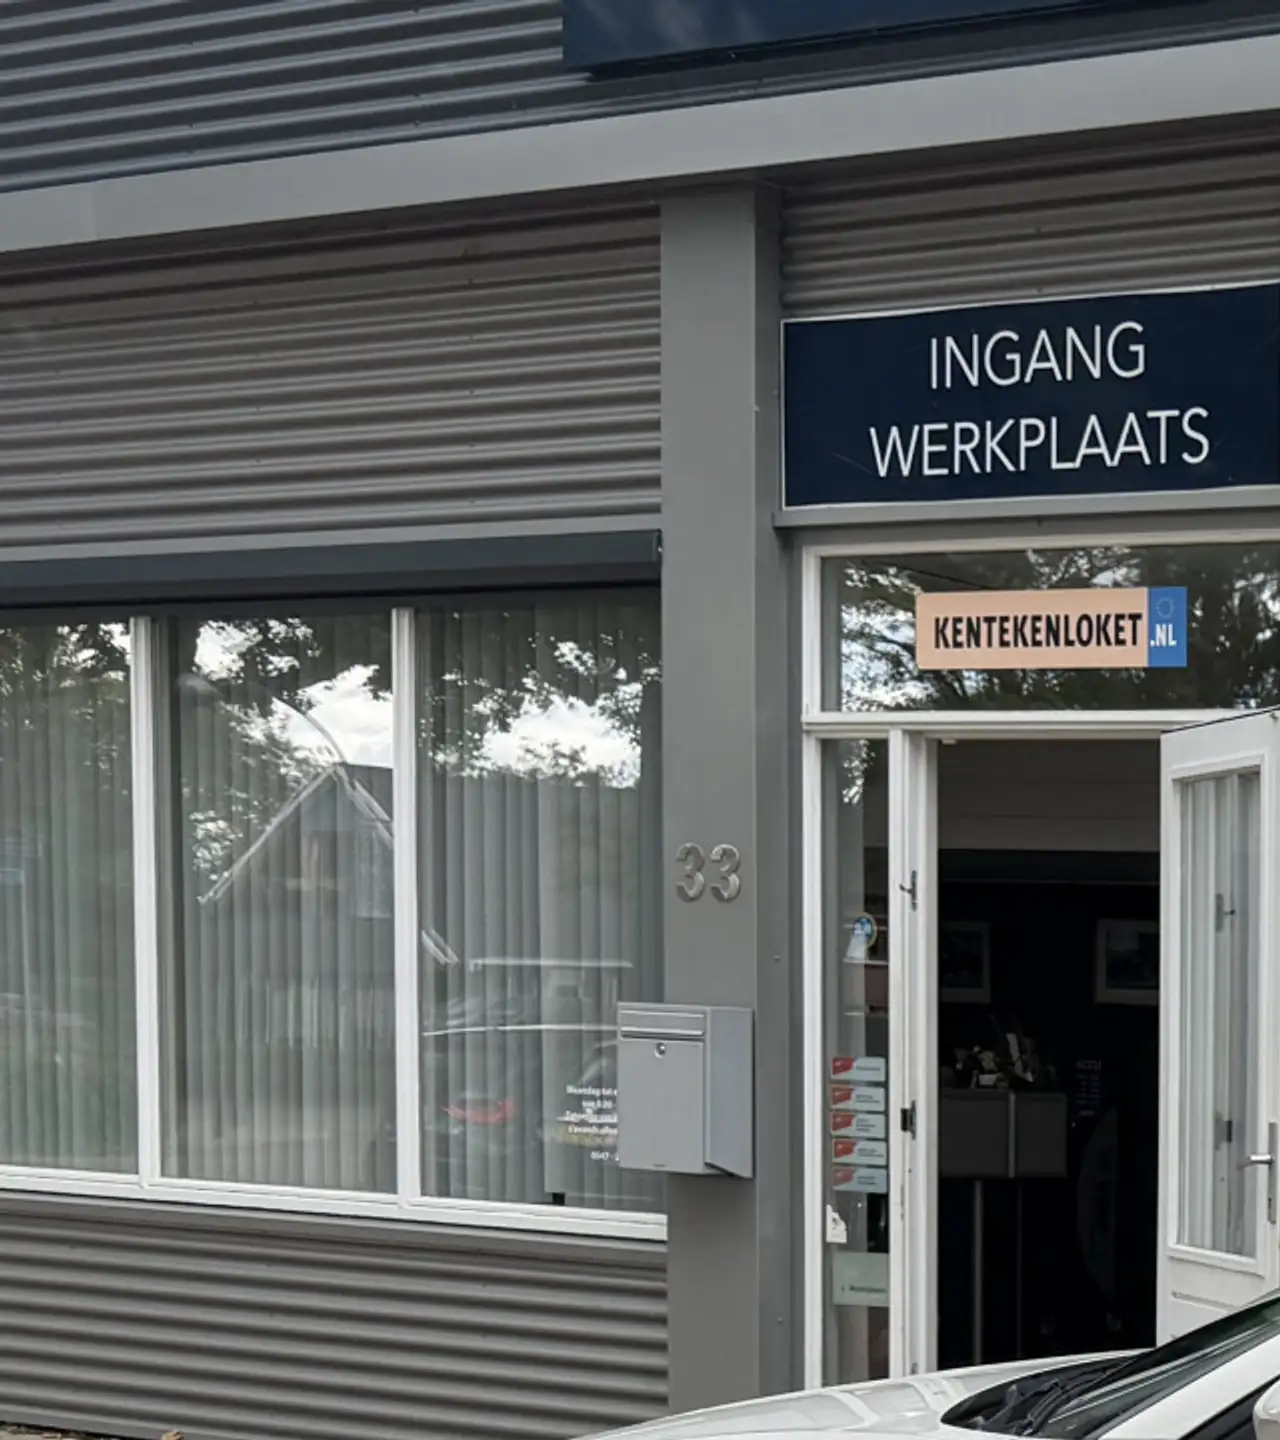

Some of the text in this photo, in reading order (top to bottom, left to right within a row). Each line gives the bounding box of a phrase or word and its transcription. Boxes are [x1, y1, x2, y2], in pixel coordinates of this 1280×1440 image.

[929, 321, 1146, 389] INGANG
[869, 407, 1210, 478] WERKPLAATS
[934, 613, 1143, 650] KENTEKENLOKET
[675, 842, 741, 902] 33
